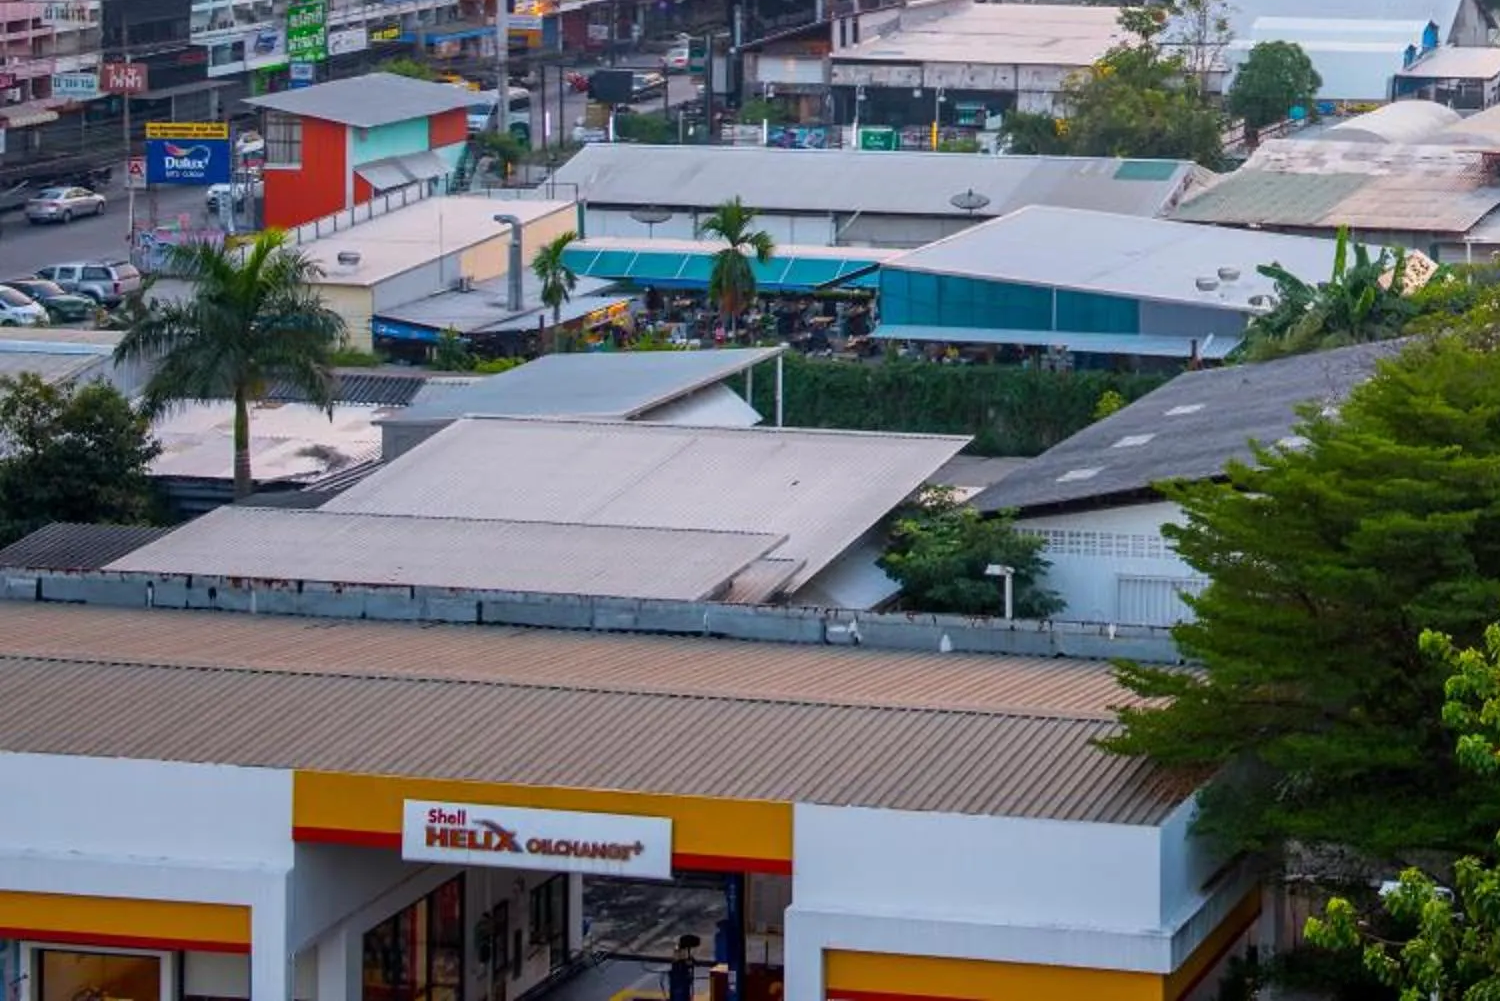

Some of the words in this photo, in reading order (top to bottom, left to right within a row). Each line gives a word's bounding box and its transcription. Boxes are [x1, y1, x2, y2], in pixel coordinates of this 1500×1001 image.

[164, 156, 206, 170] Dulux
[428, 807, 467, 826] Shell
[425, 824, 521, 854] HELIX
